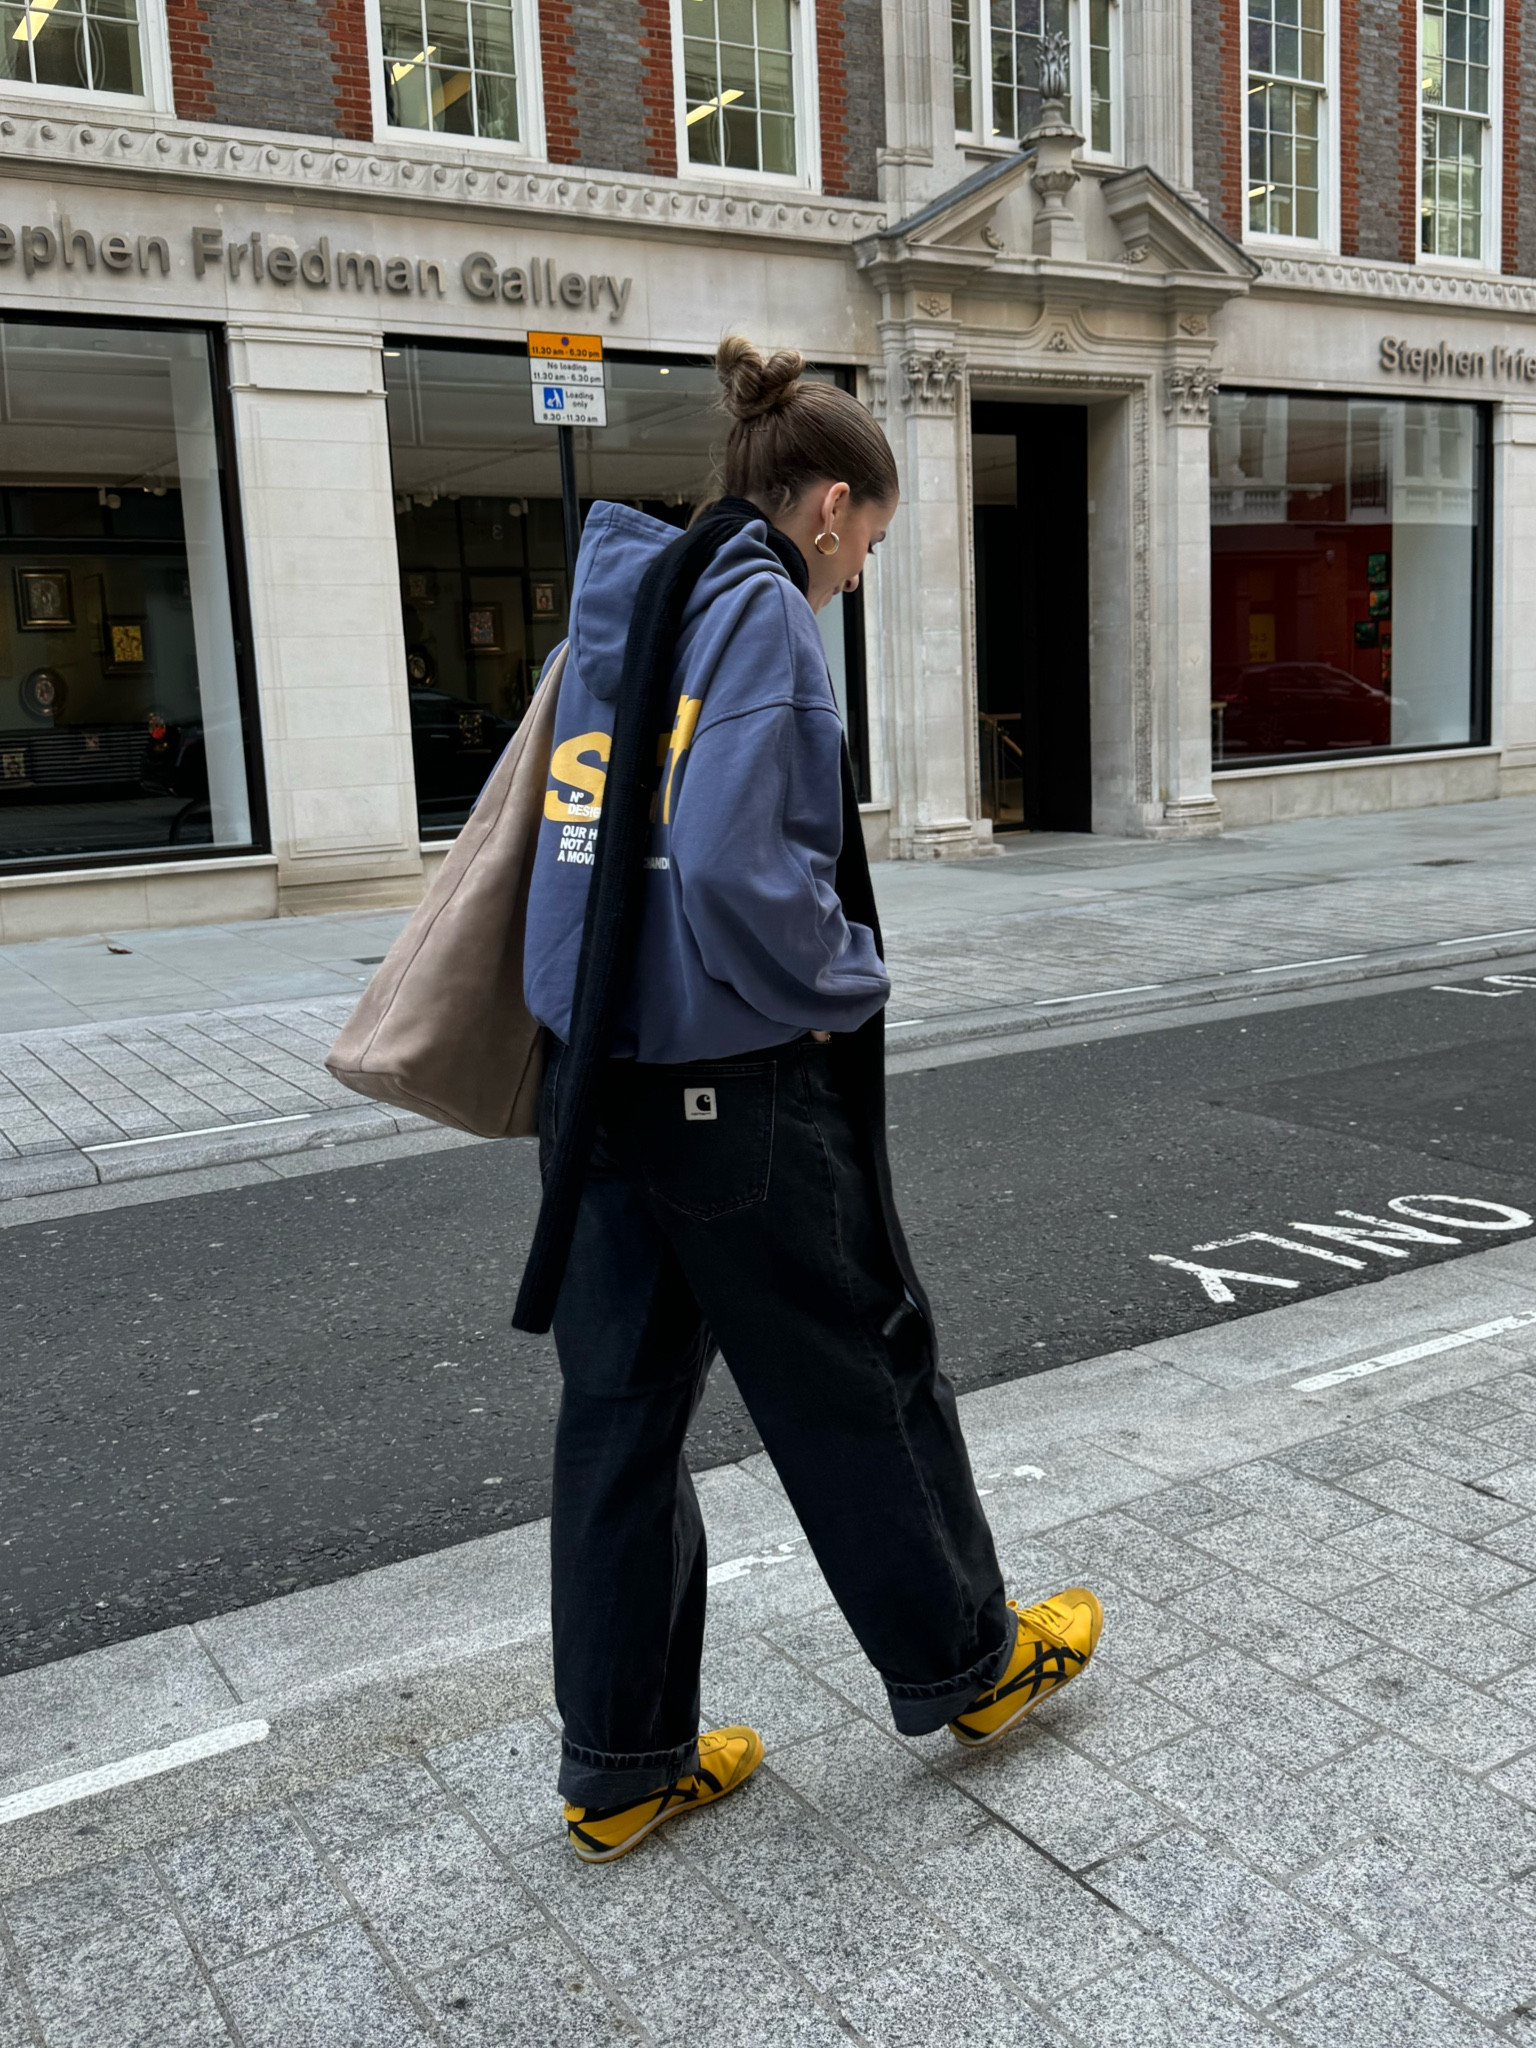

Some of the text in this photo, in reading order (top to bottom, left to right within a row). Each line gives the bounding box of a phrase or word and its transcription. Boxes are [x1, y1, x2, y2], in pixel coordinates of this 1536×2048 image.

[192, 226, 446, 295] Friedman
[461, 250, 633, 319] Gallery
[531, 346, 552, 355] 11.30
[569, 348, 587, 357] 6.30
[588, 350, 600, 358] pm
[1379, 335, 1487, 383] Stephen
[547, 361, 587, 373] No loading
[533, 372, 553, 381] 11.30
[571, 373, 589, 382] 6.30
[590, 376, 601, 384] pm
[565, 391, 594, 401] Loading
[572, 401, 588, 409] only
[543, 413, 561, 421] 8.30
[566, 414, 586, 422] 11.30
[562, 824, 587, 839] OUR
[560, 837, 584, 851] NOT
[557, 850, 565, 862] A
[1149, 1194, 1534, 1303] ONLY
